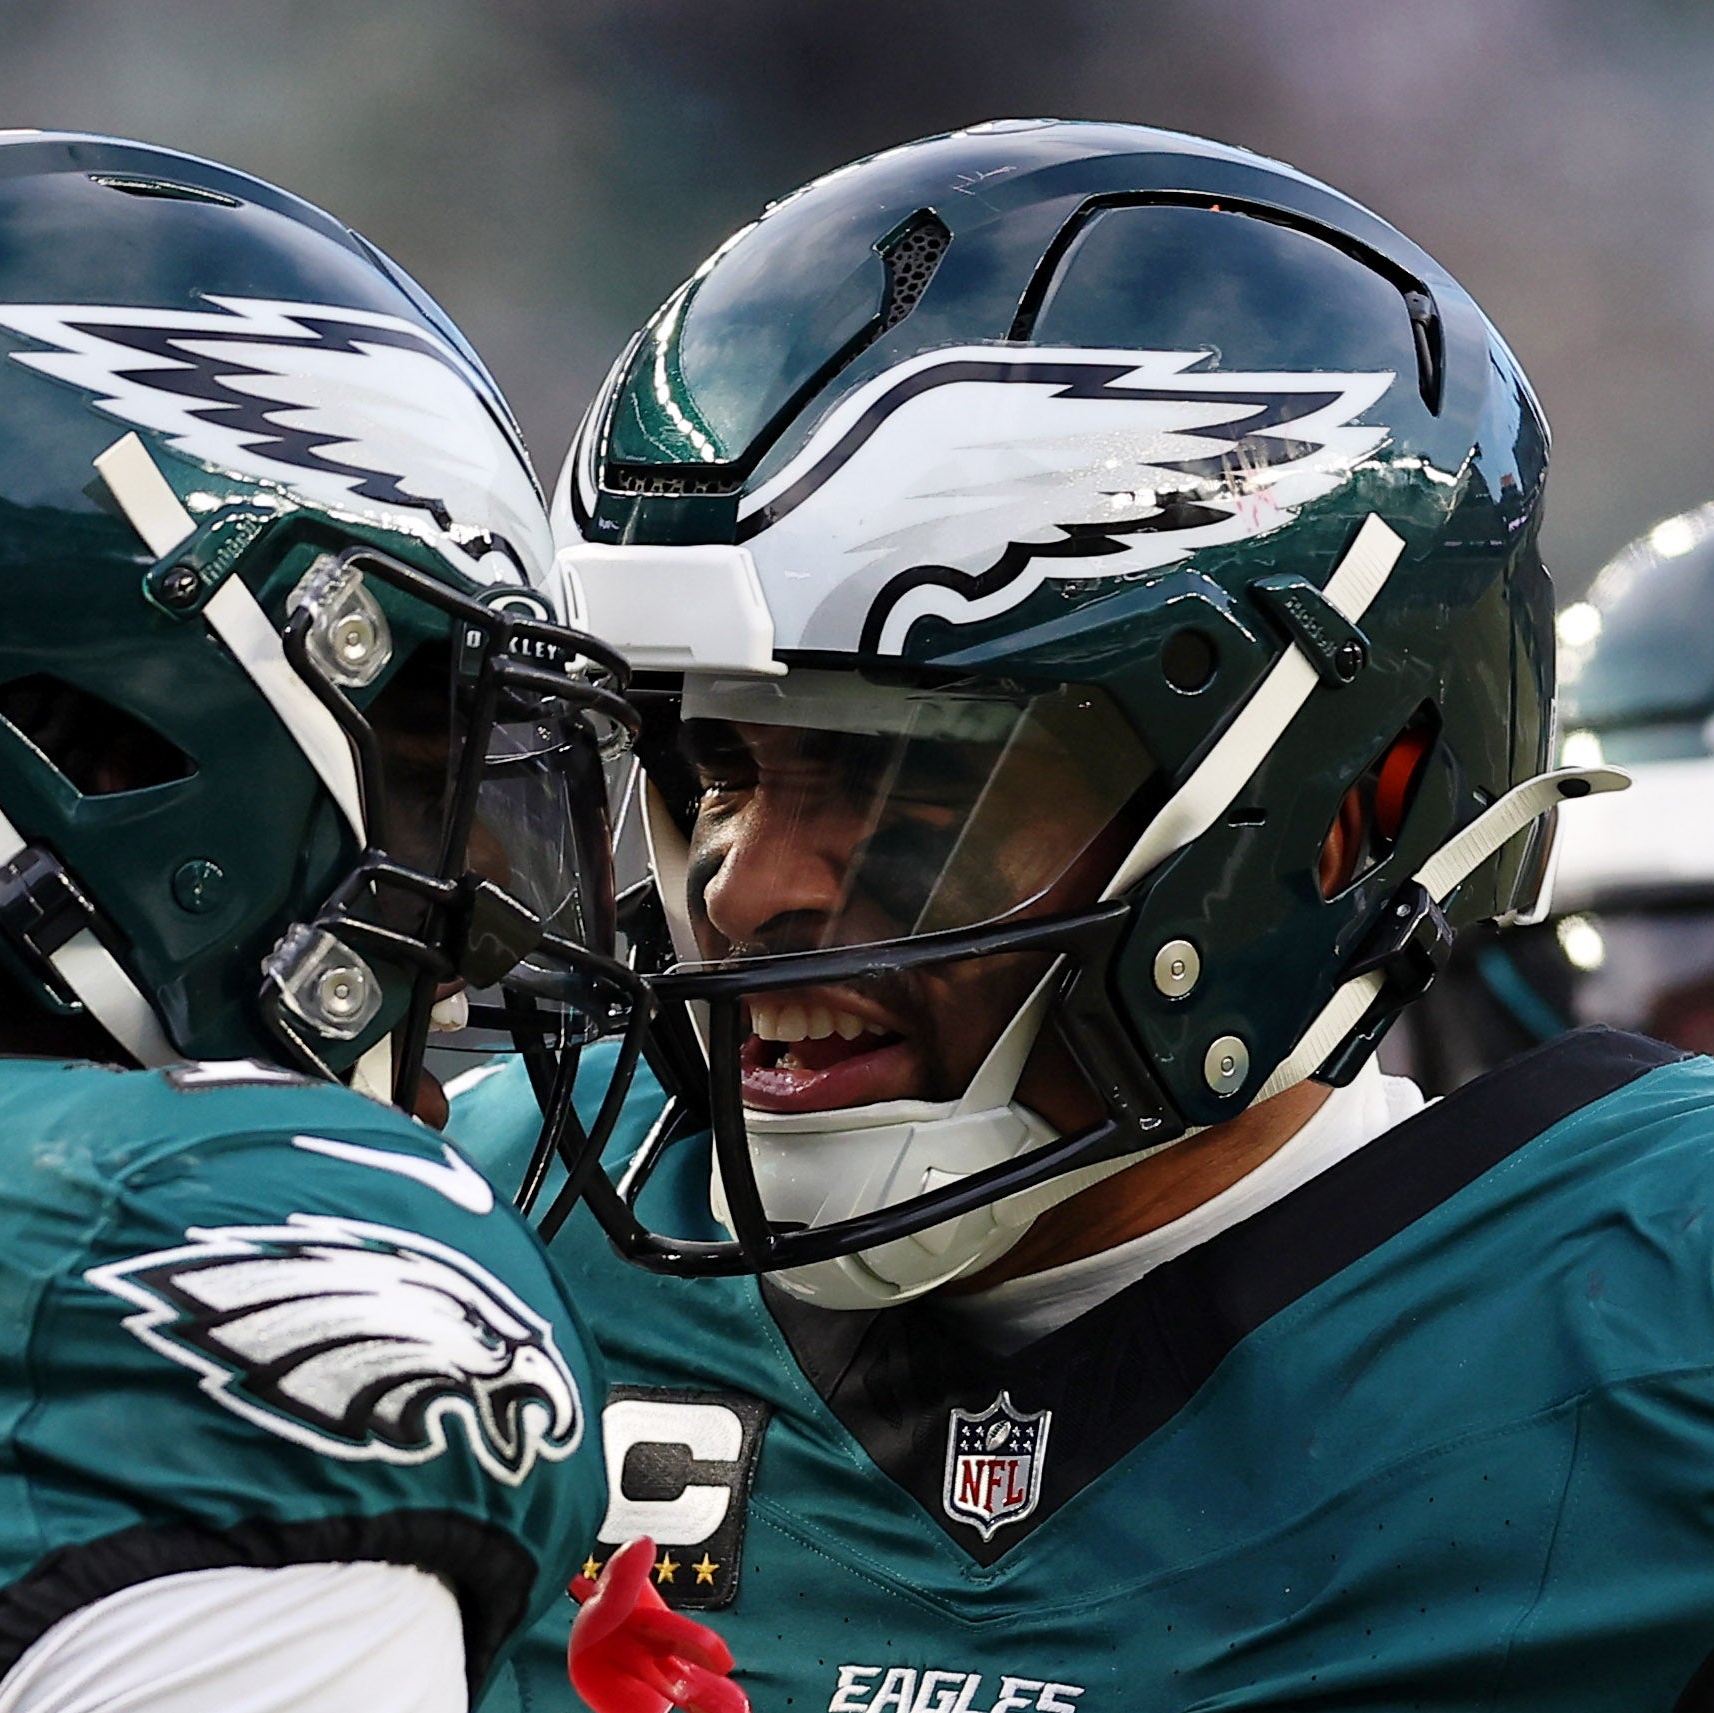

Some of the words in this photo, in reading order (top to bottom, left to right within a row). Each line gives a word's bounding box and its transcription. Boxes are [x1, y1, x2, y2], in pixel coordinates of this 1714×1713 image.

[466, 630, 557, 660] OKLEY
[597, 1399, 744, 1545] C
[959, 1458, 1025, 1513] NFL
